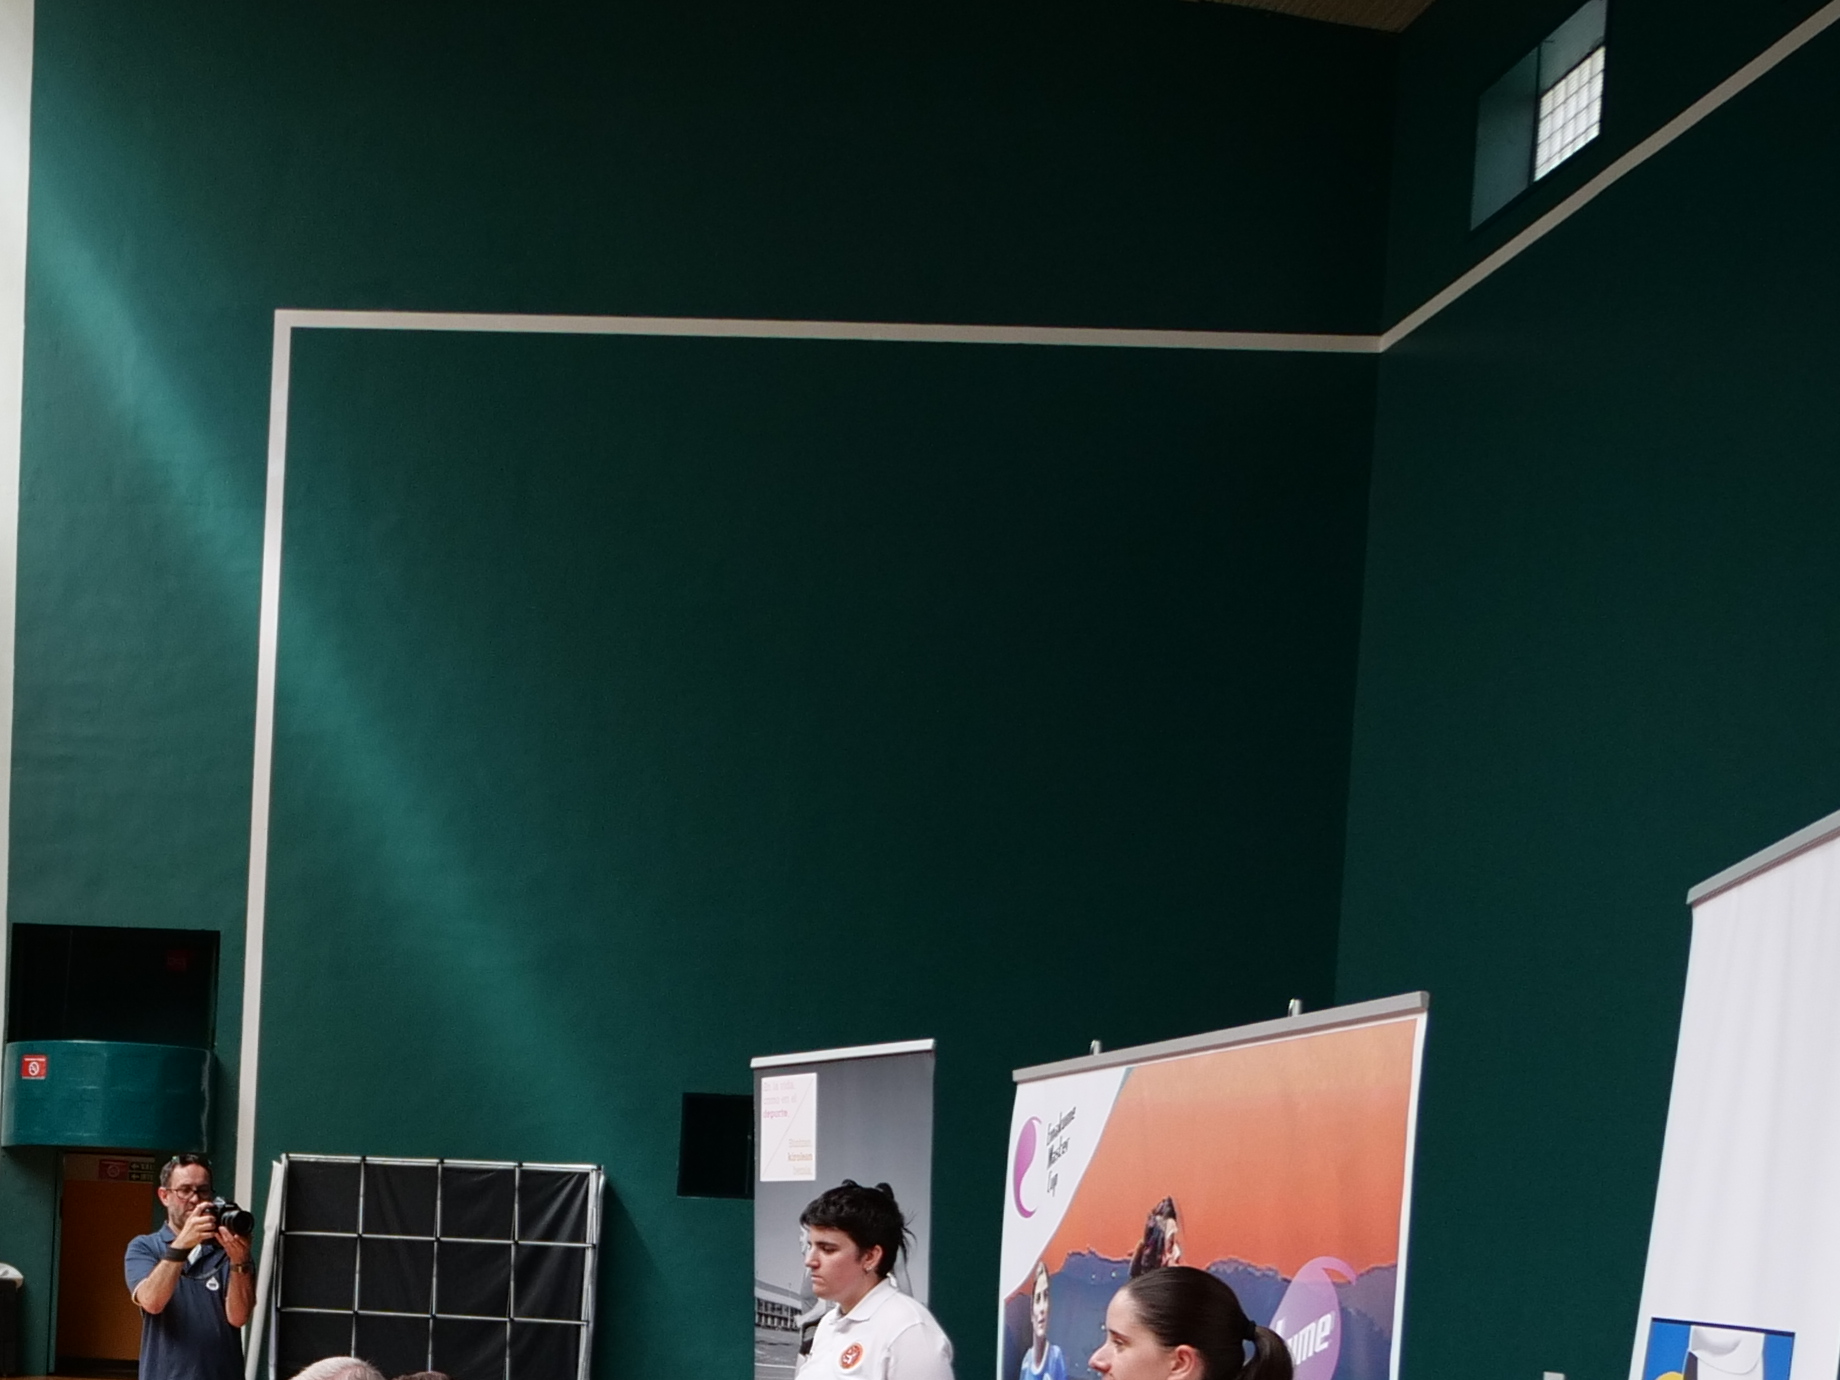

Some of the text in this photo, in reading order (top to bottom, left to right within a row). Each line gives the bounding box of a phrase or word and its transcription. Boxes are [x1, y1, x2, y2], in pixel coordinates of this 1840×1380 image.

[1046, 1106, 1076, 1147] Emakume
[1046, 1137, 1070, 1170] Master
[1046, 1170, 1058, 1198] Cup
